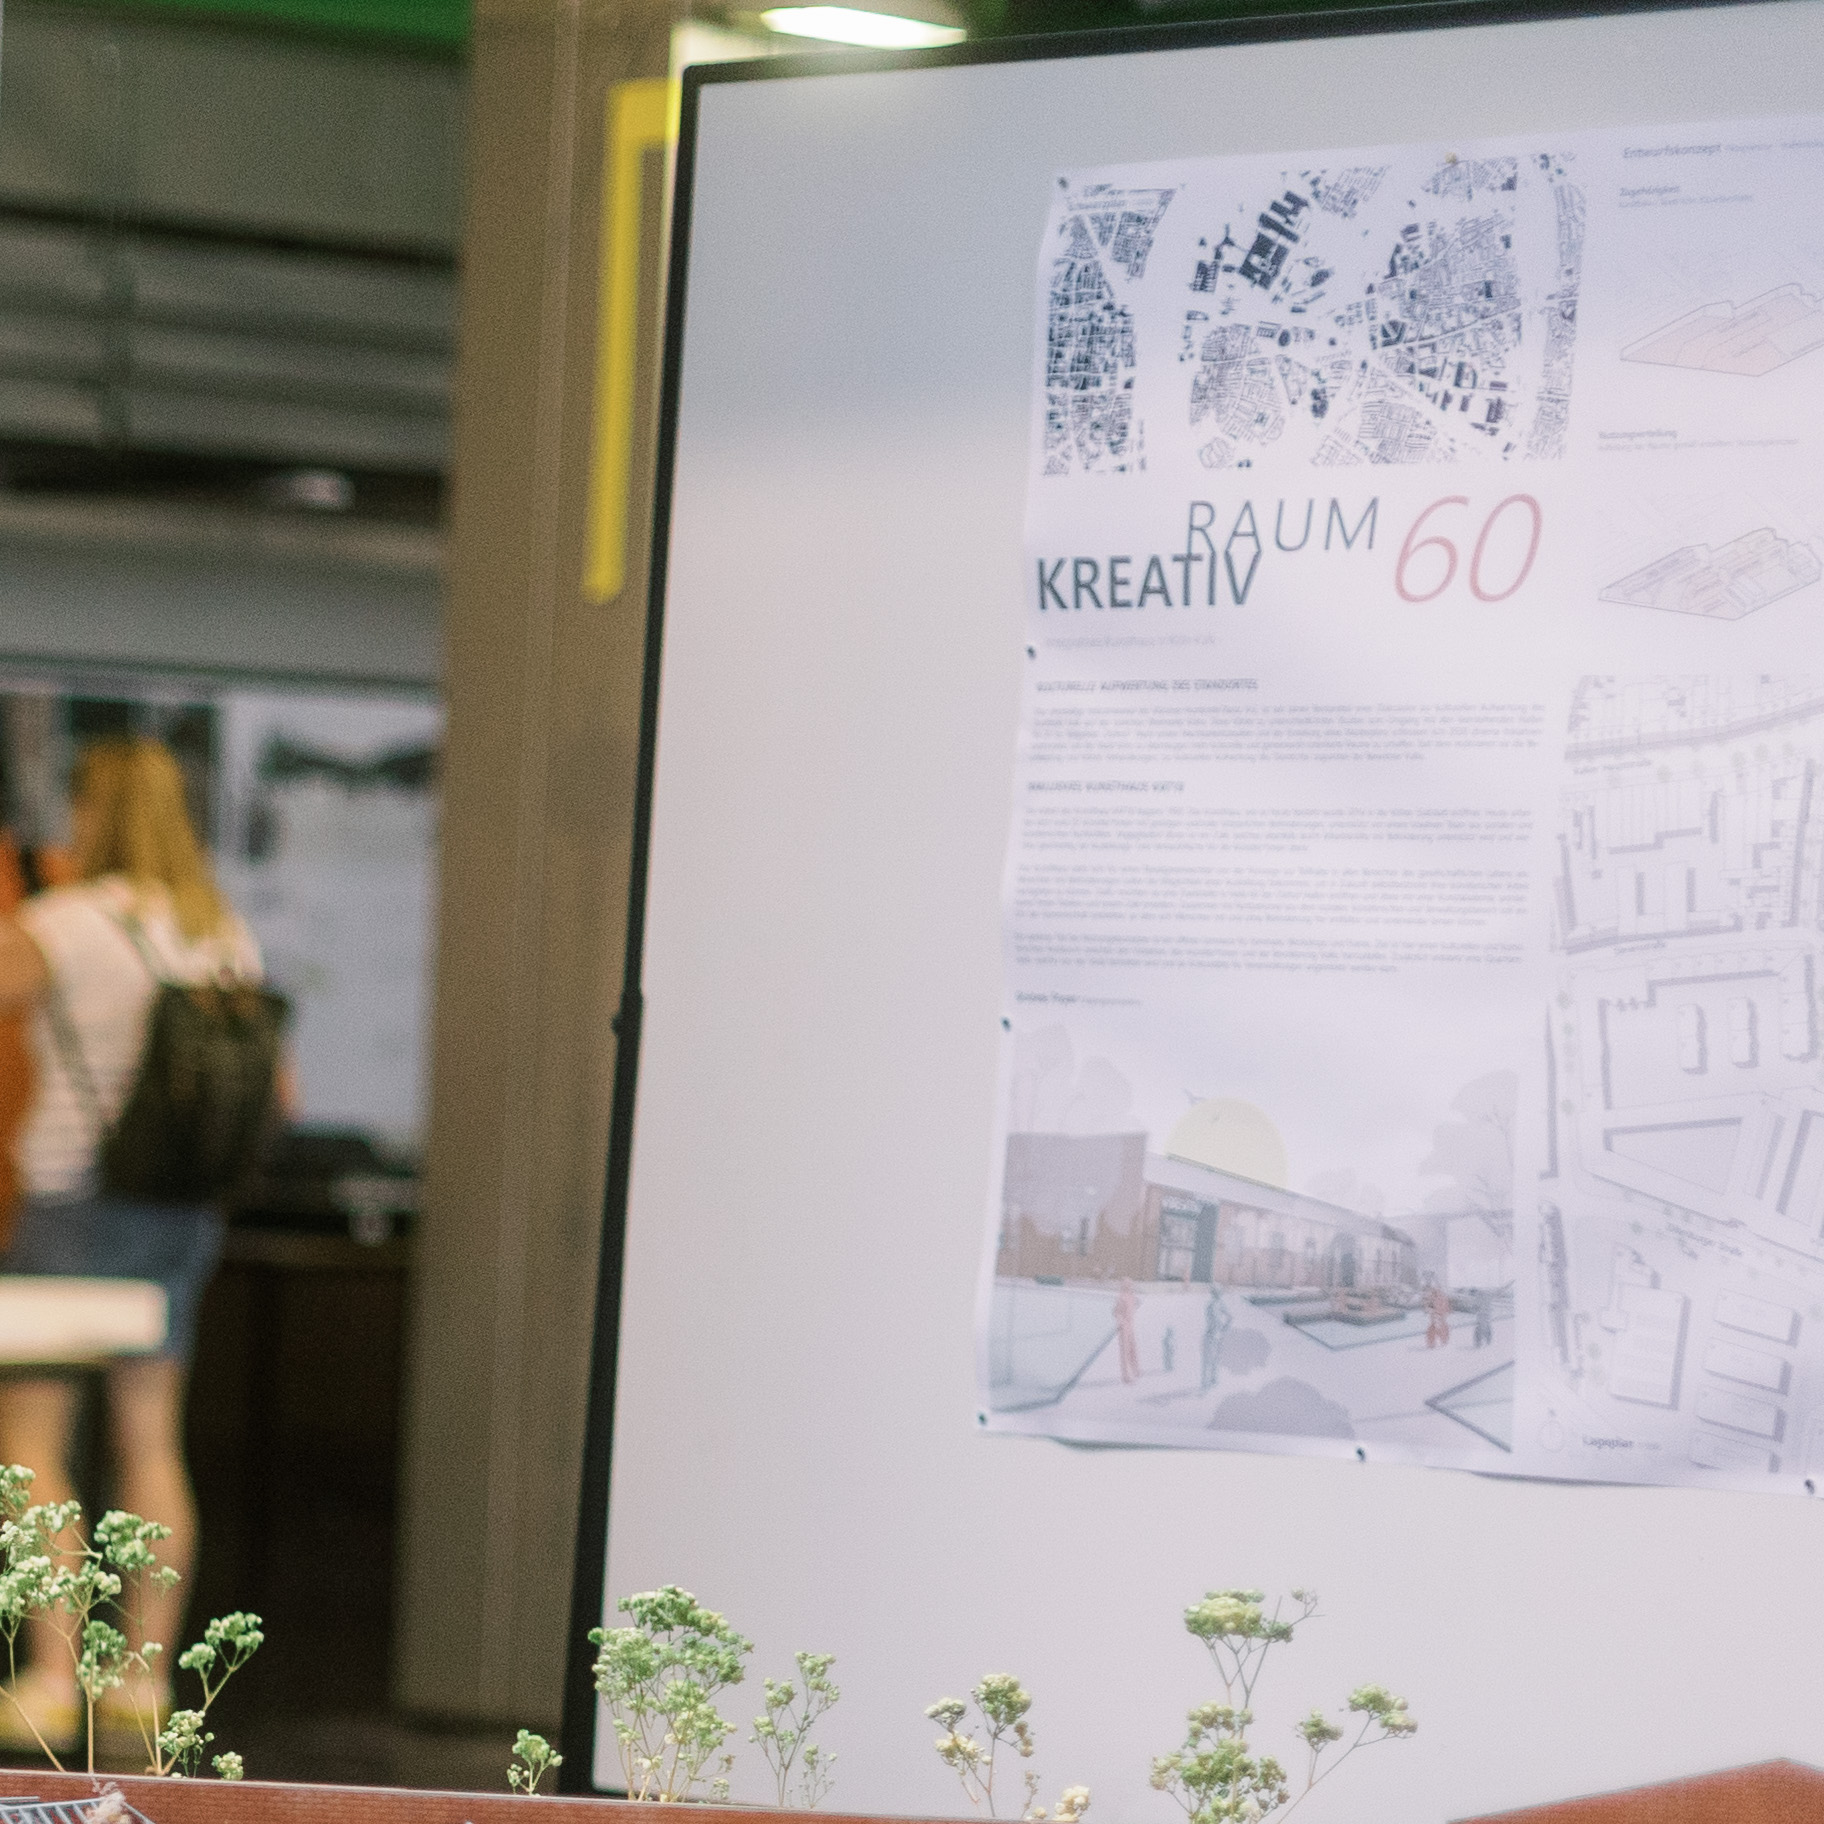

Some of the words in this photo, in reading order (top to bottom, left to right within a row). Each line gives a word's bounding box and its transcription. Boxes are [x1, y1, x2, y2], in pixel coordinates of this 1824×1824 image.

[1036, 551, 1263, 611] KREATIV
[1186, 496, 1380, 554] RAUM
[1393, 493, 1544, 603] 60
